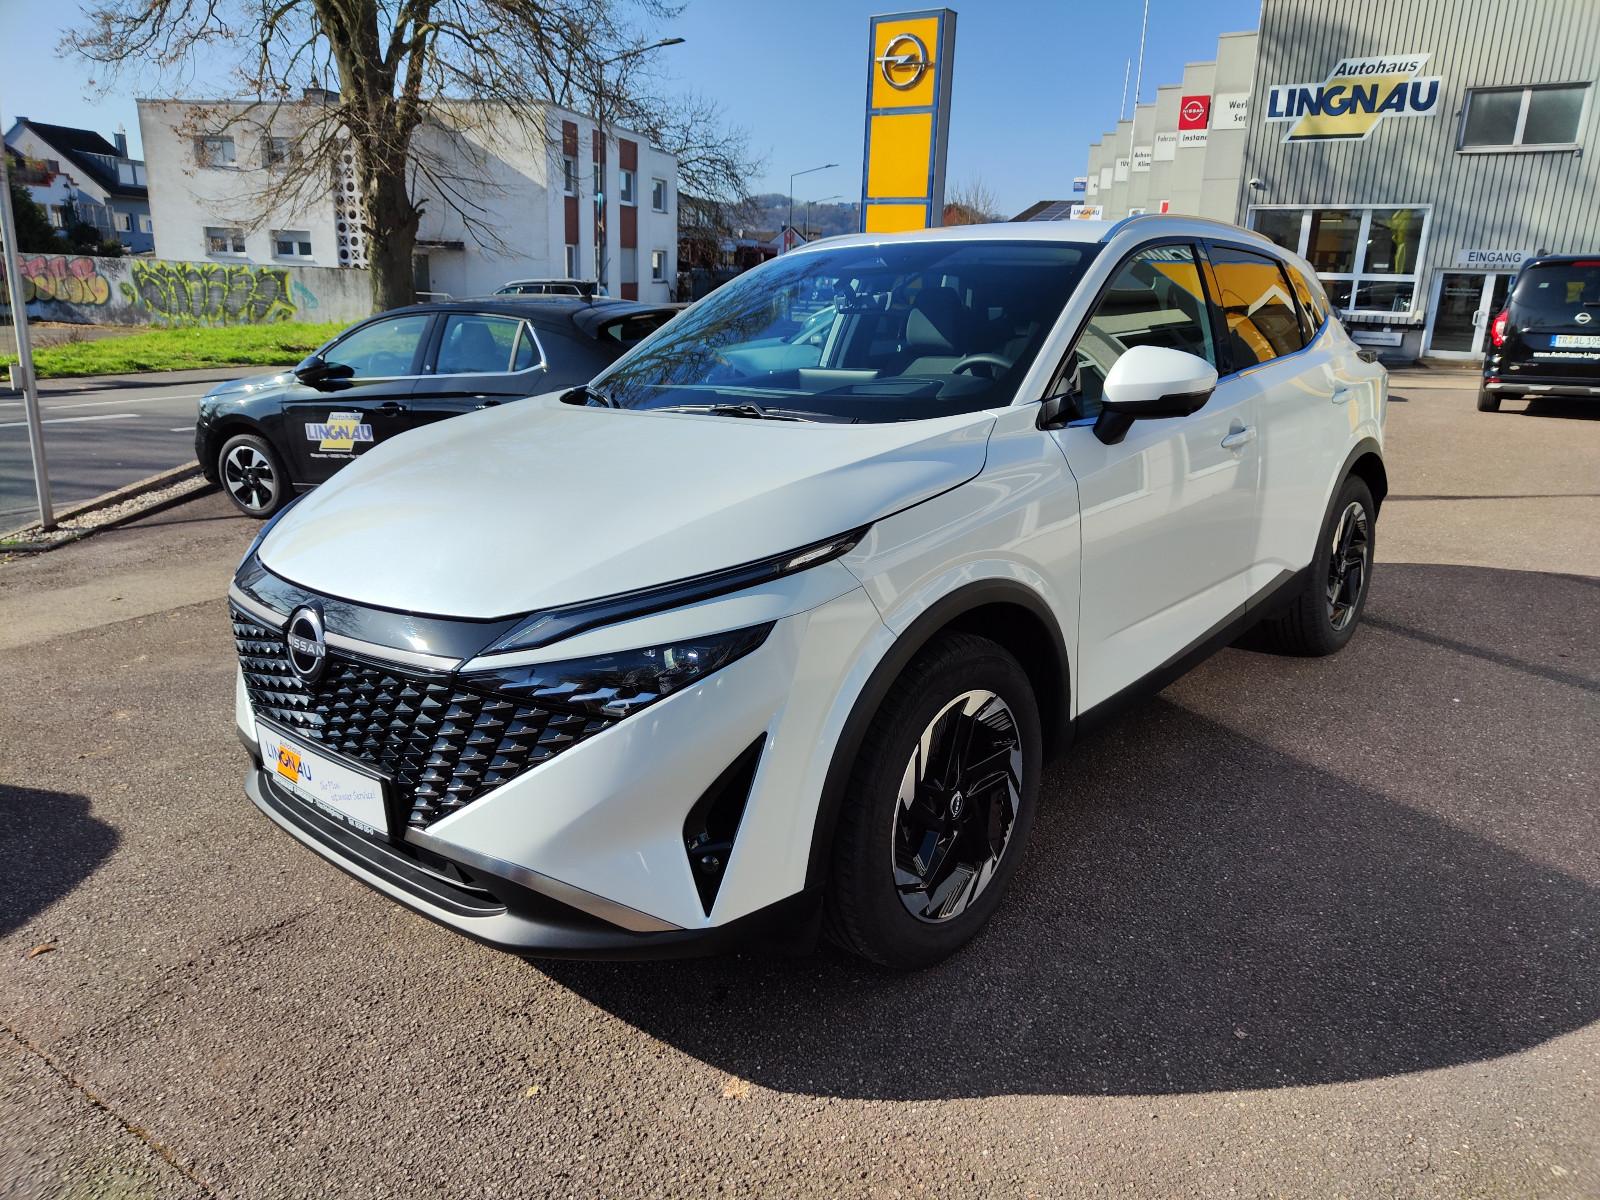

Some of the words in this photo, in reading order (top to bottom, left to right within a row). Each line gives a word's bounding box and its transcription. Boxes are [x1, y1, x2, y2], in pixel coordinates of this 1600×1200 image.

[1334, 60, 1419, 76] Autohaus
[1267, 80, 1440, 117] LINGNAU
[1467, 251, 1522, 263] EINGANG
[306, 424, 372, 440] LINGNAU
[265, 740, 312, 781] LINGNAU
